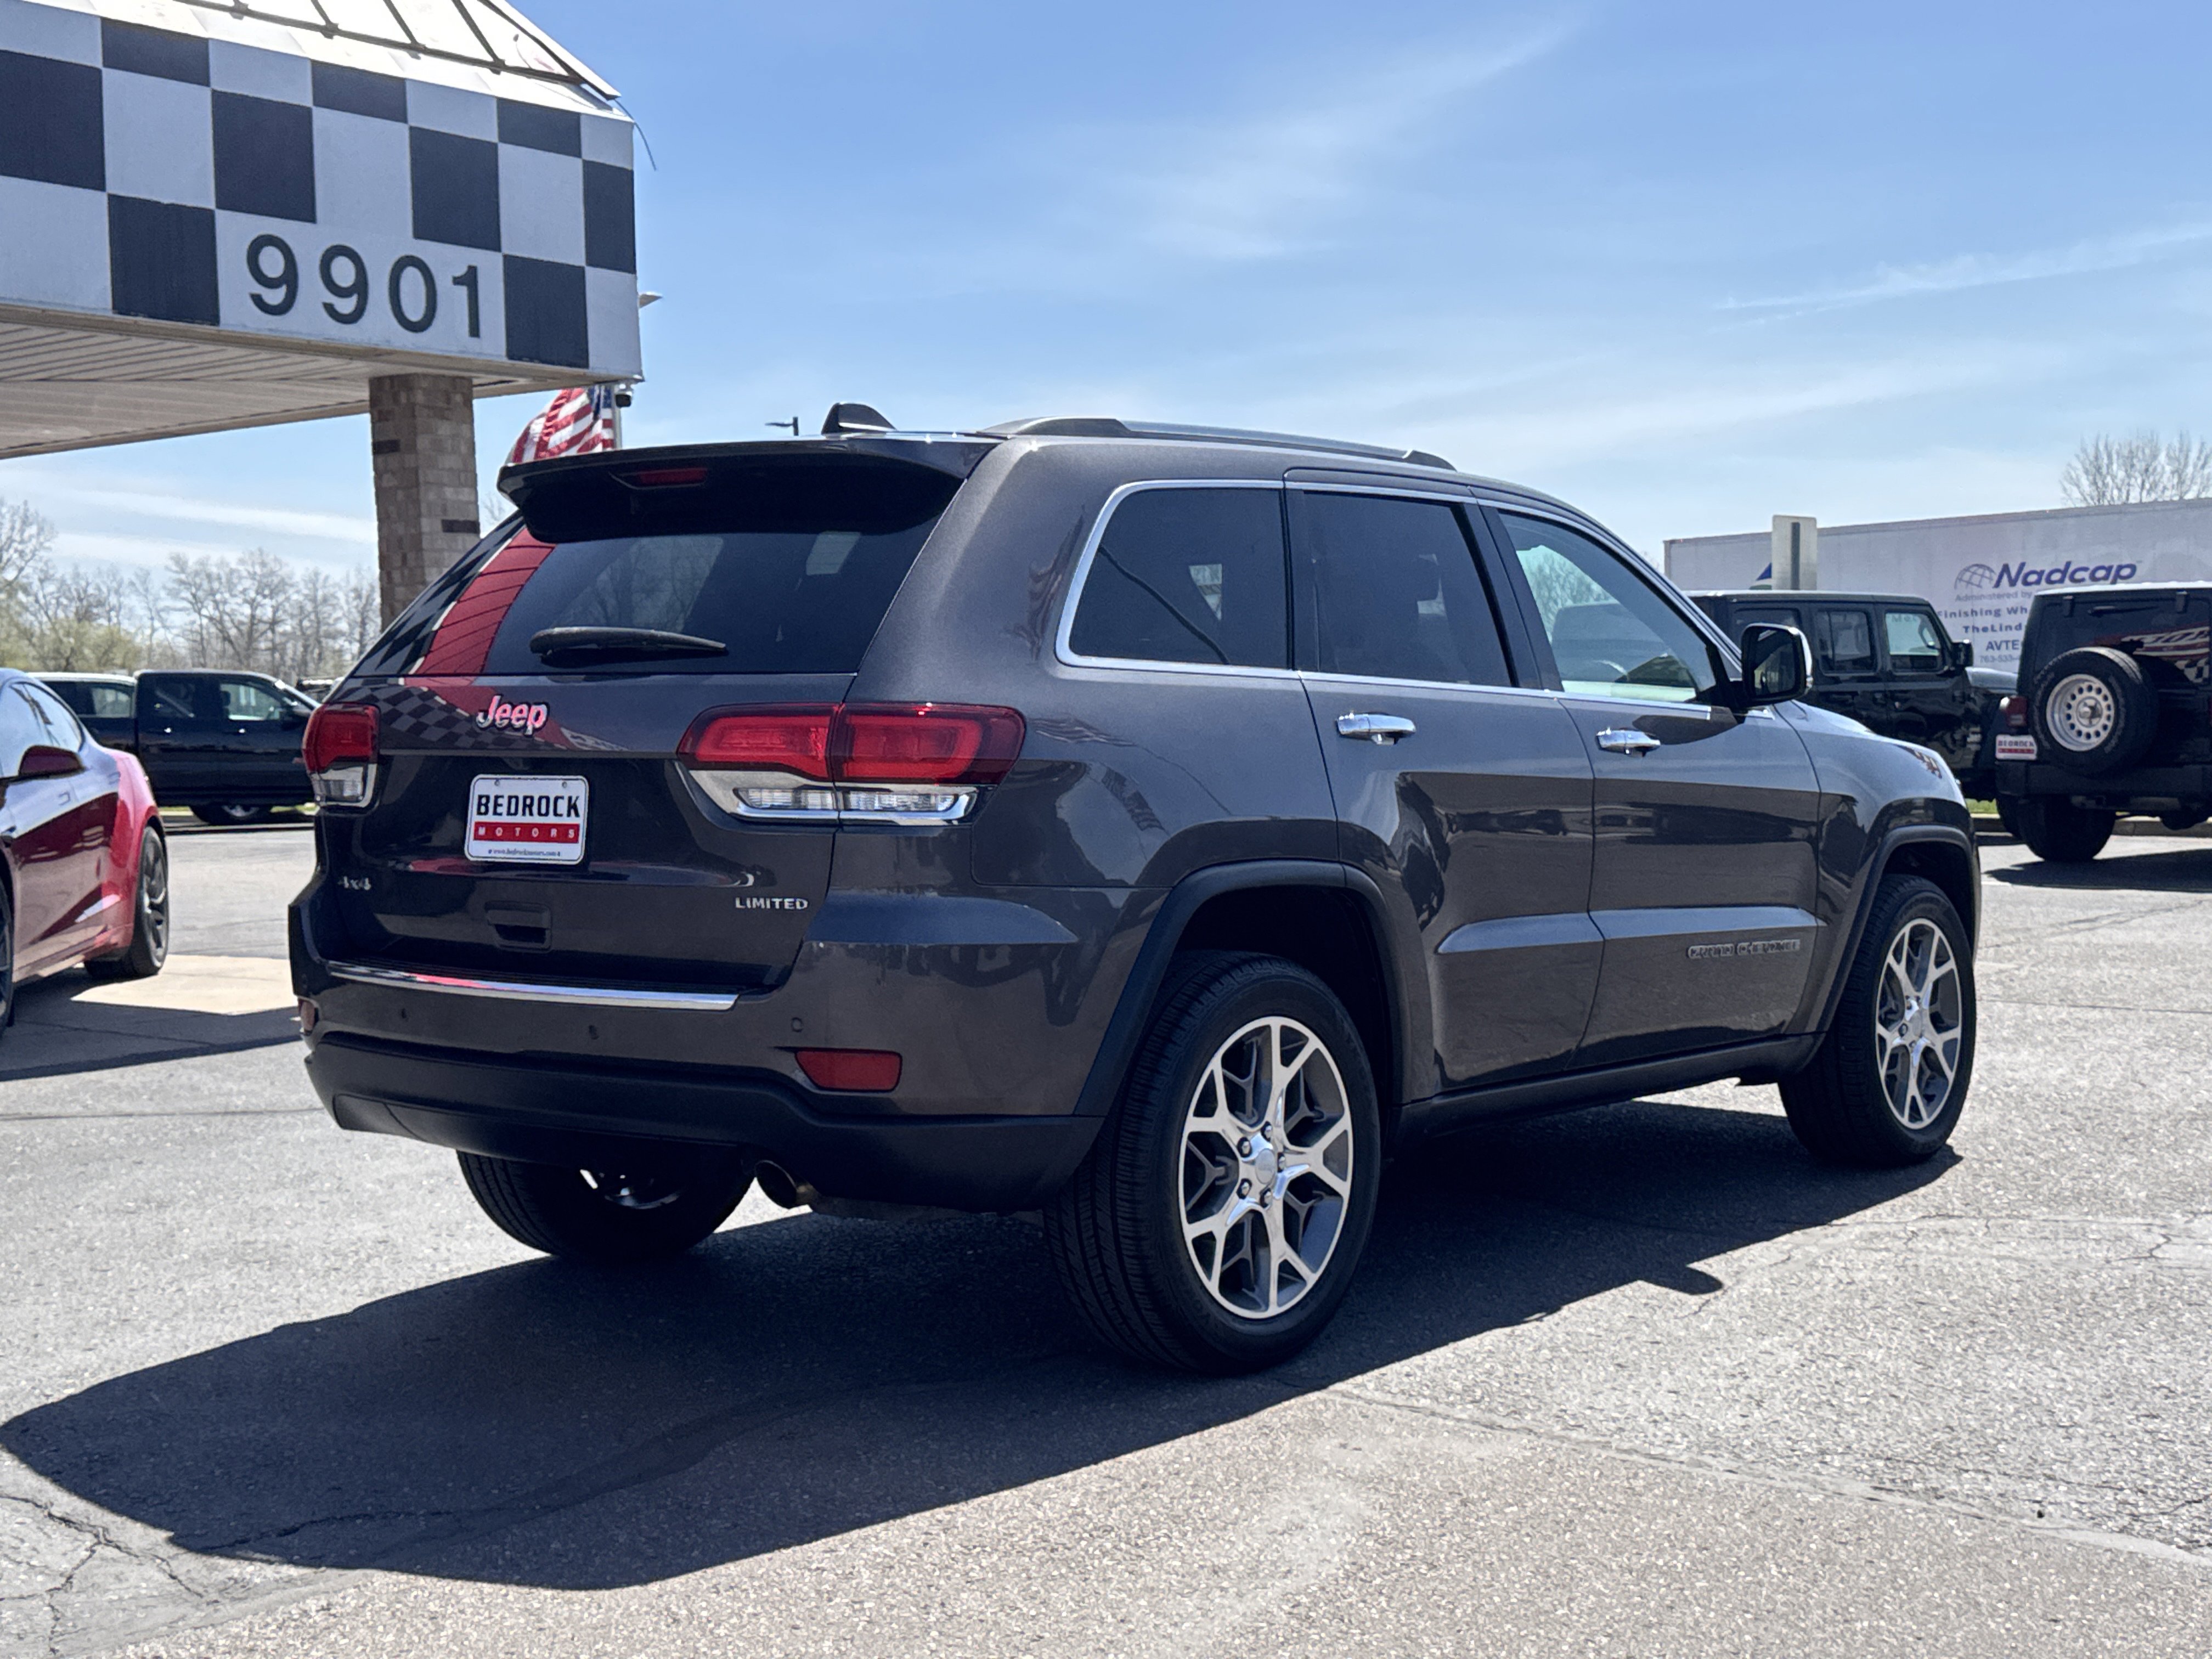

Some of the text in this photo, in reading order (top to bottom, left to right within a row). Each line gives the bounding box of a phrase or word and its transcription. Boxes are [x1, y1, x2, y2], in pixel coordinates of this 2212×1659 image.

[246, 234, 481, 338] 9901
[1993, 561, 2137, 589] Nadcap
[1985, 639, 2020, 651] AVTE
[1979, 653, 2020, 664] 763-533-
[476, 695, 548, 735] Jeep
[476, 794, 580, 818] BEDROCK
[478, 826, 575, 839] MOTORS
[735, 897, 809, 910] LIMITED
